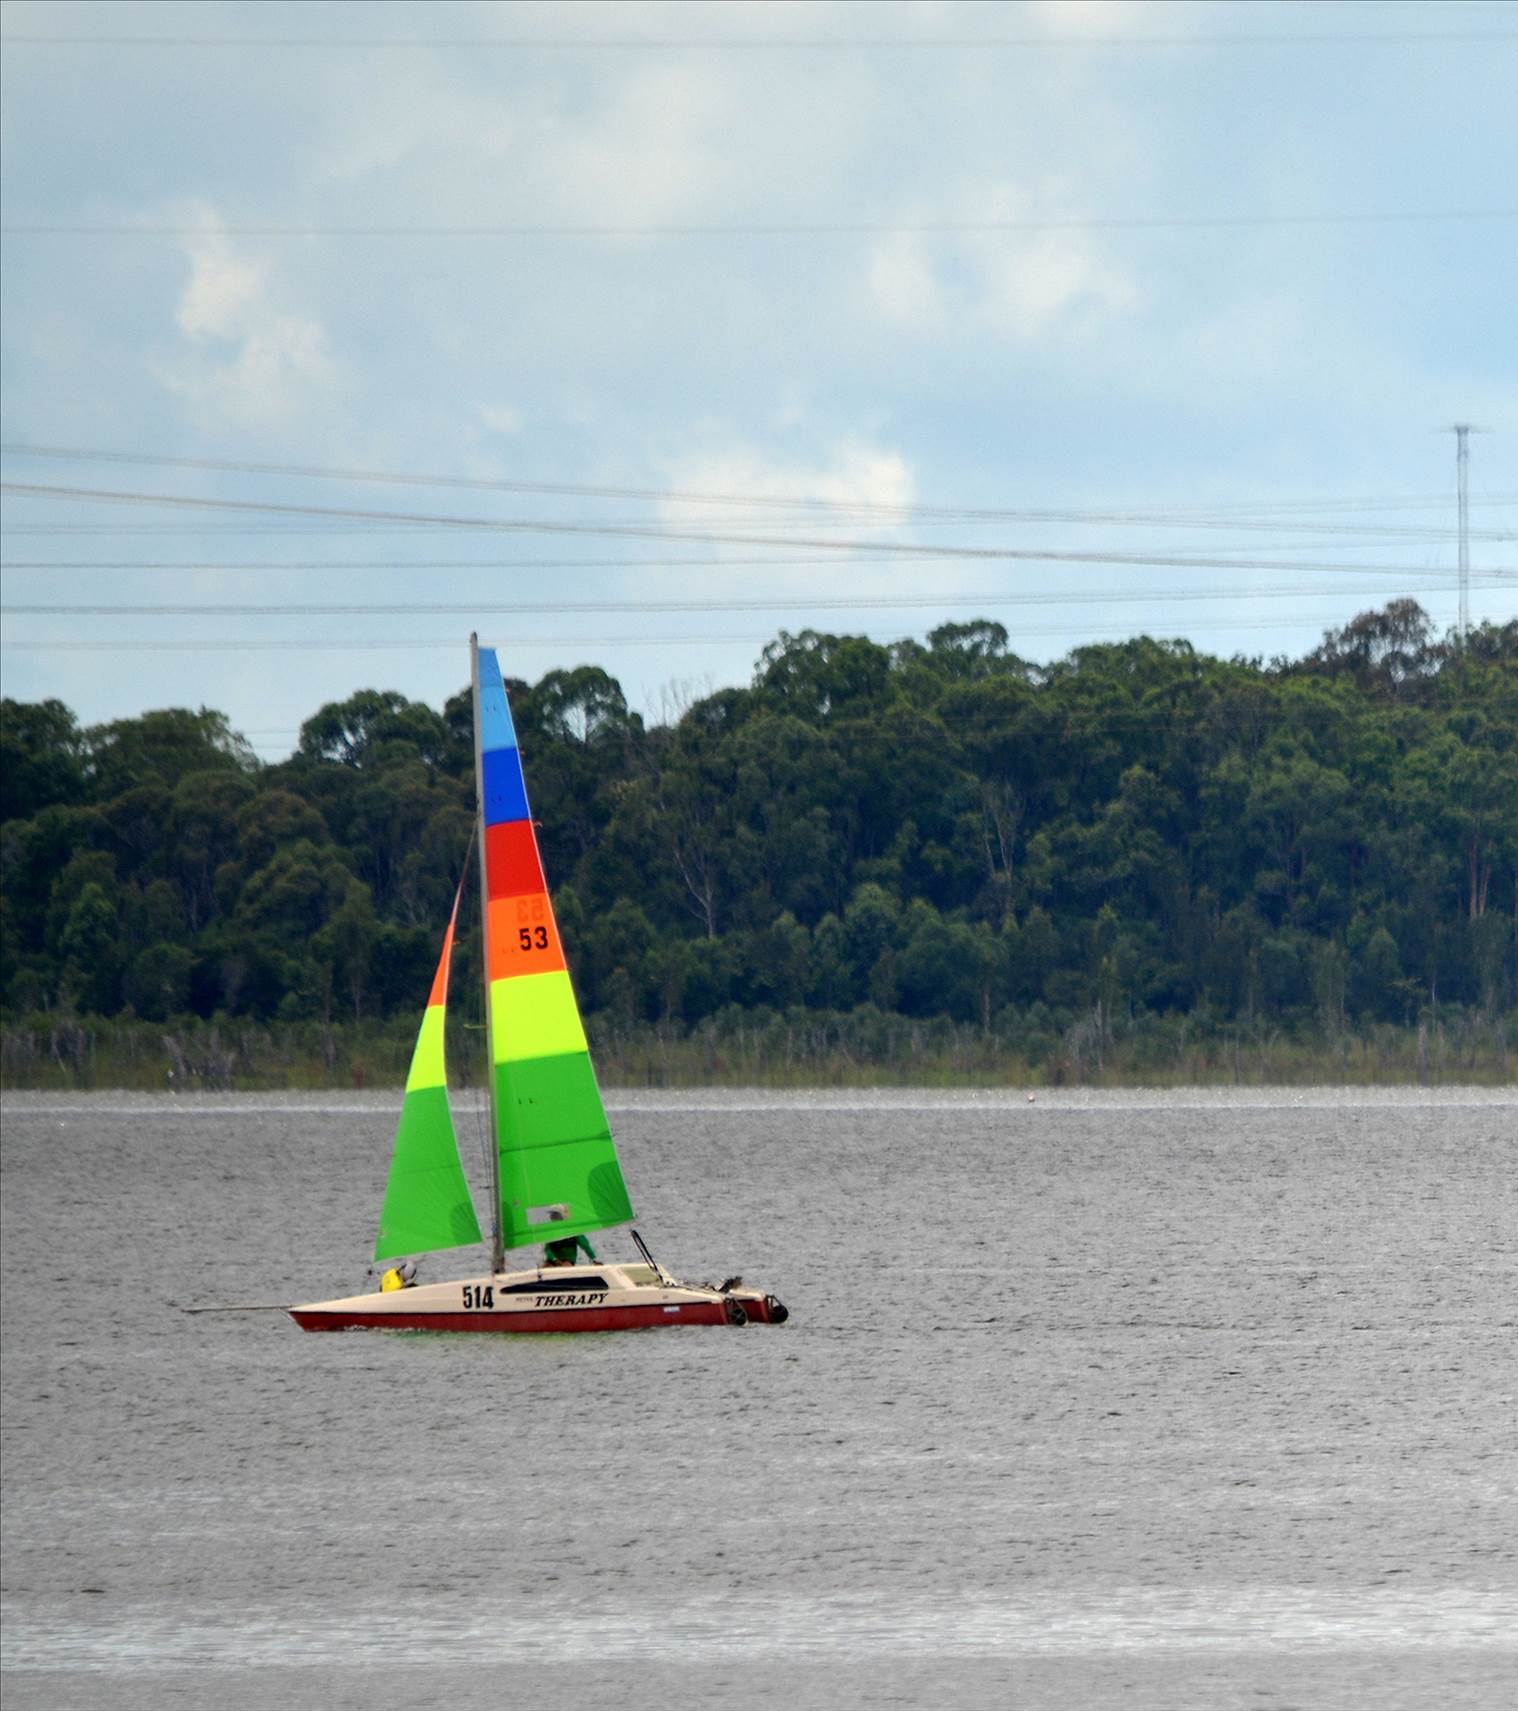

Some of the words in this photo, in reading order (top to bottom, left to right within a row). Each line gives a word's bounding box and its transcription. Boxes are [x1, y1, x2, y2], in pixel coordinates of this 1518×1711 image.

[519, 926, 549, 951] 53
[462, 1285, 495, 1310] 514
[535, 1292, 609, 1308] THERAPY
